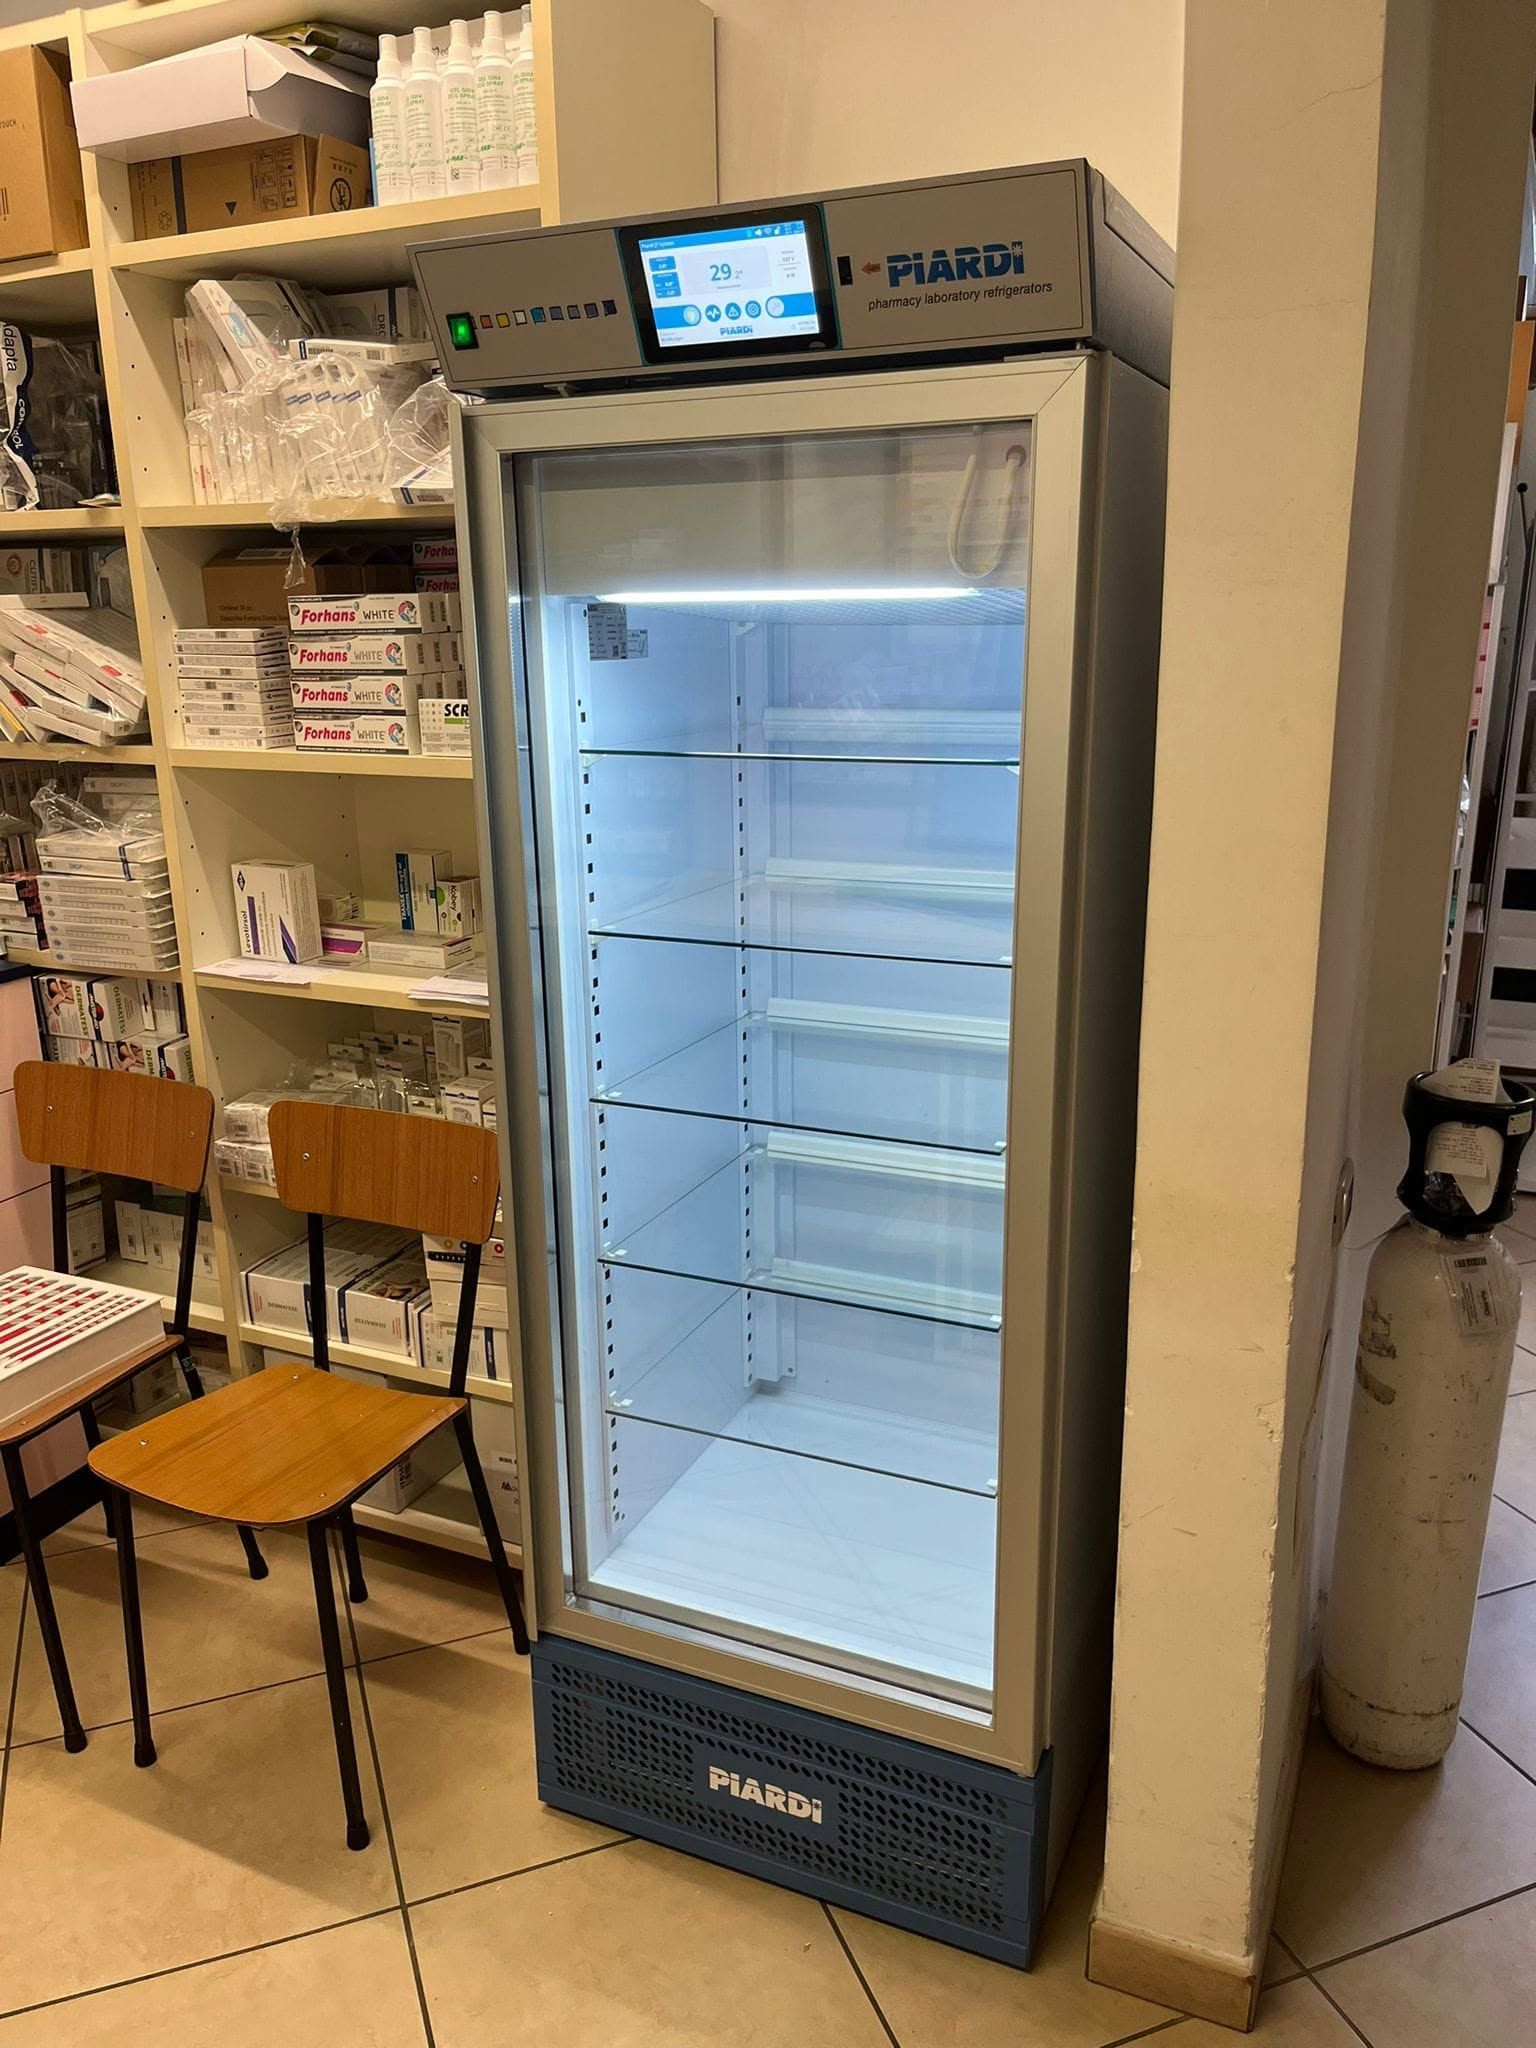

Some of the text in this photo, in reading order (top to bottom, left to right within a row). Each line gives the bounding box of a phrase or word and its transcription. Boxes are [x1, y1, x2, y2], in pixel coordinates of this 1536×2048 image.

[868, 281, 1053, 312] pharmacy laboratory refrigerators
[300, 608, 356, 625] Forhans
[362, 608, 395, 620] WHITE
[299, 649, 383, 665] Forhans WHITE
[301, 687, 382, 703] Forhans WHITE
[304, 726, 385, 741] Forhans WHITE
[240, 910, 252, 953] Levotirsol
[74, 985, 89, 1036] DERMATESS
[113, 986, 126, 1034] DERMATESS
